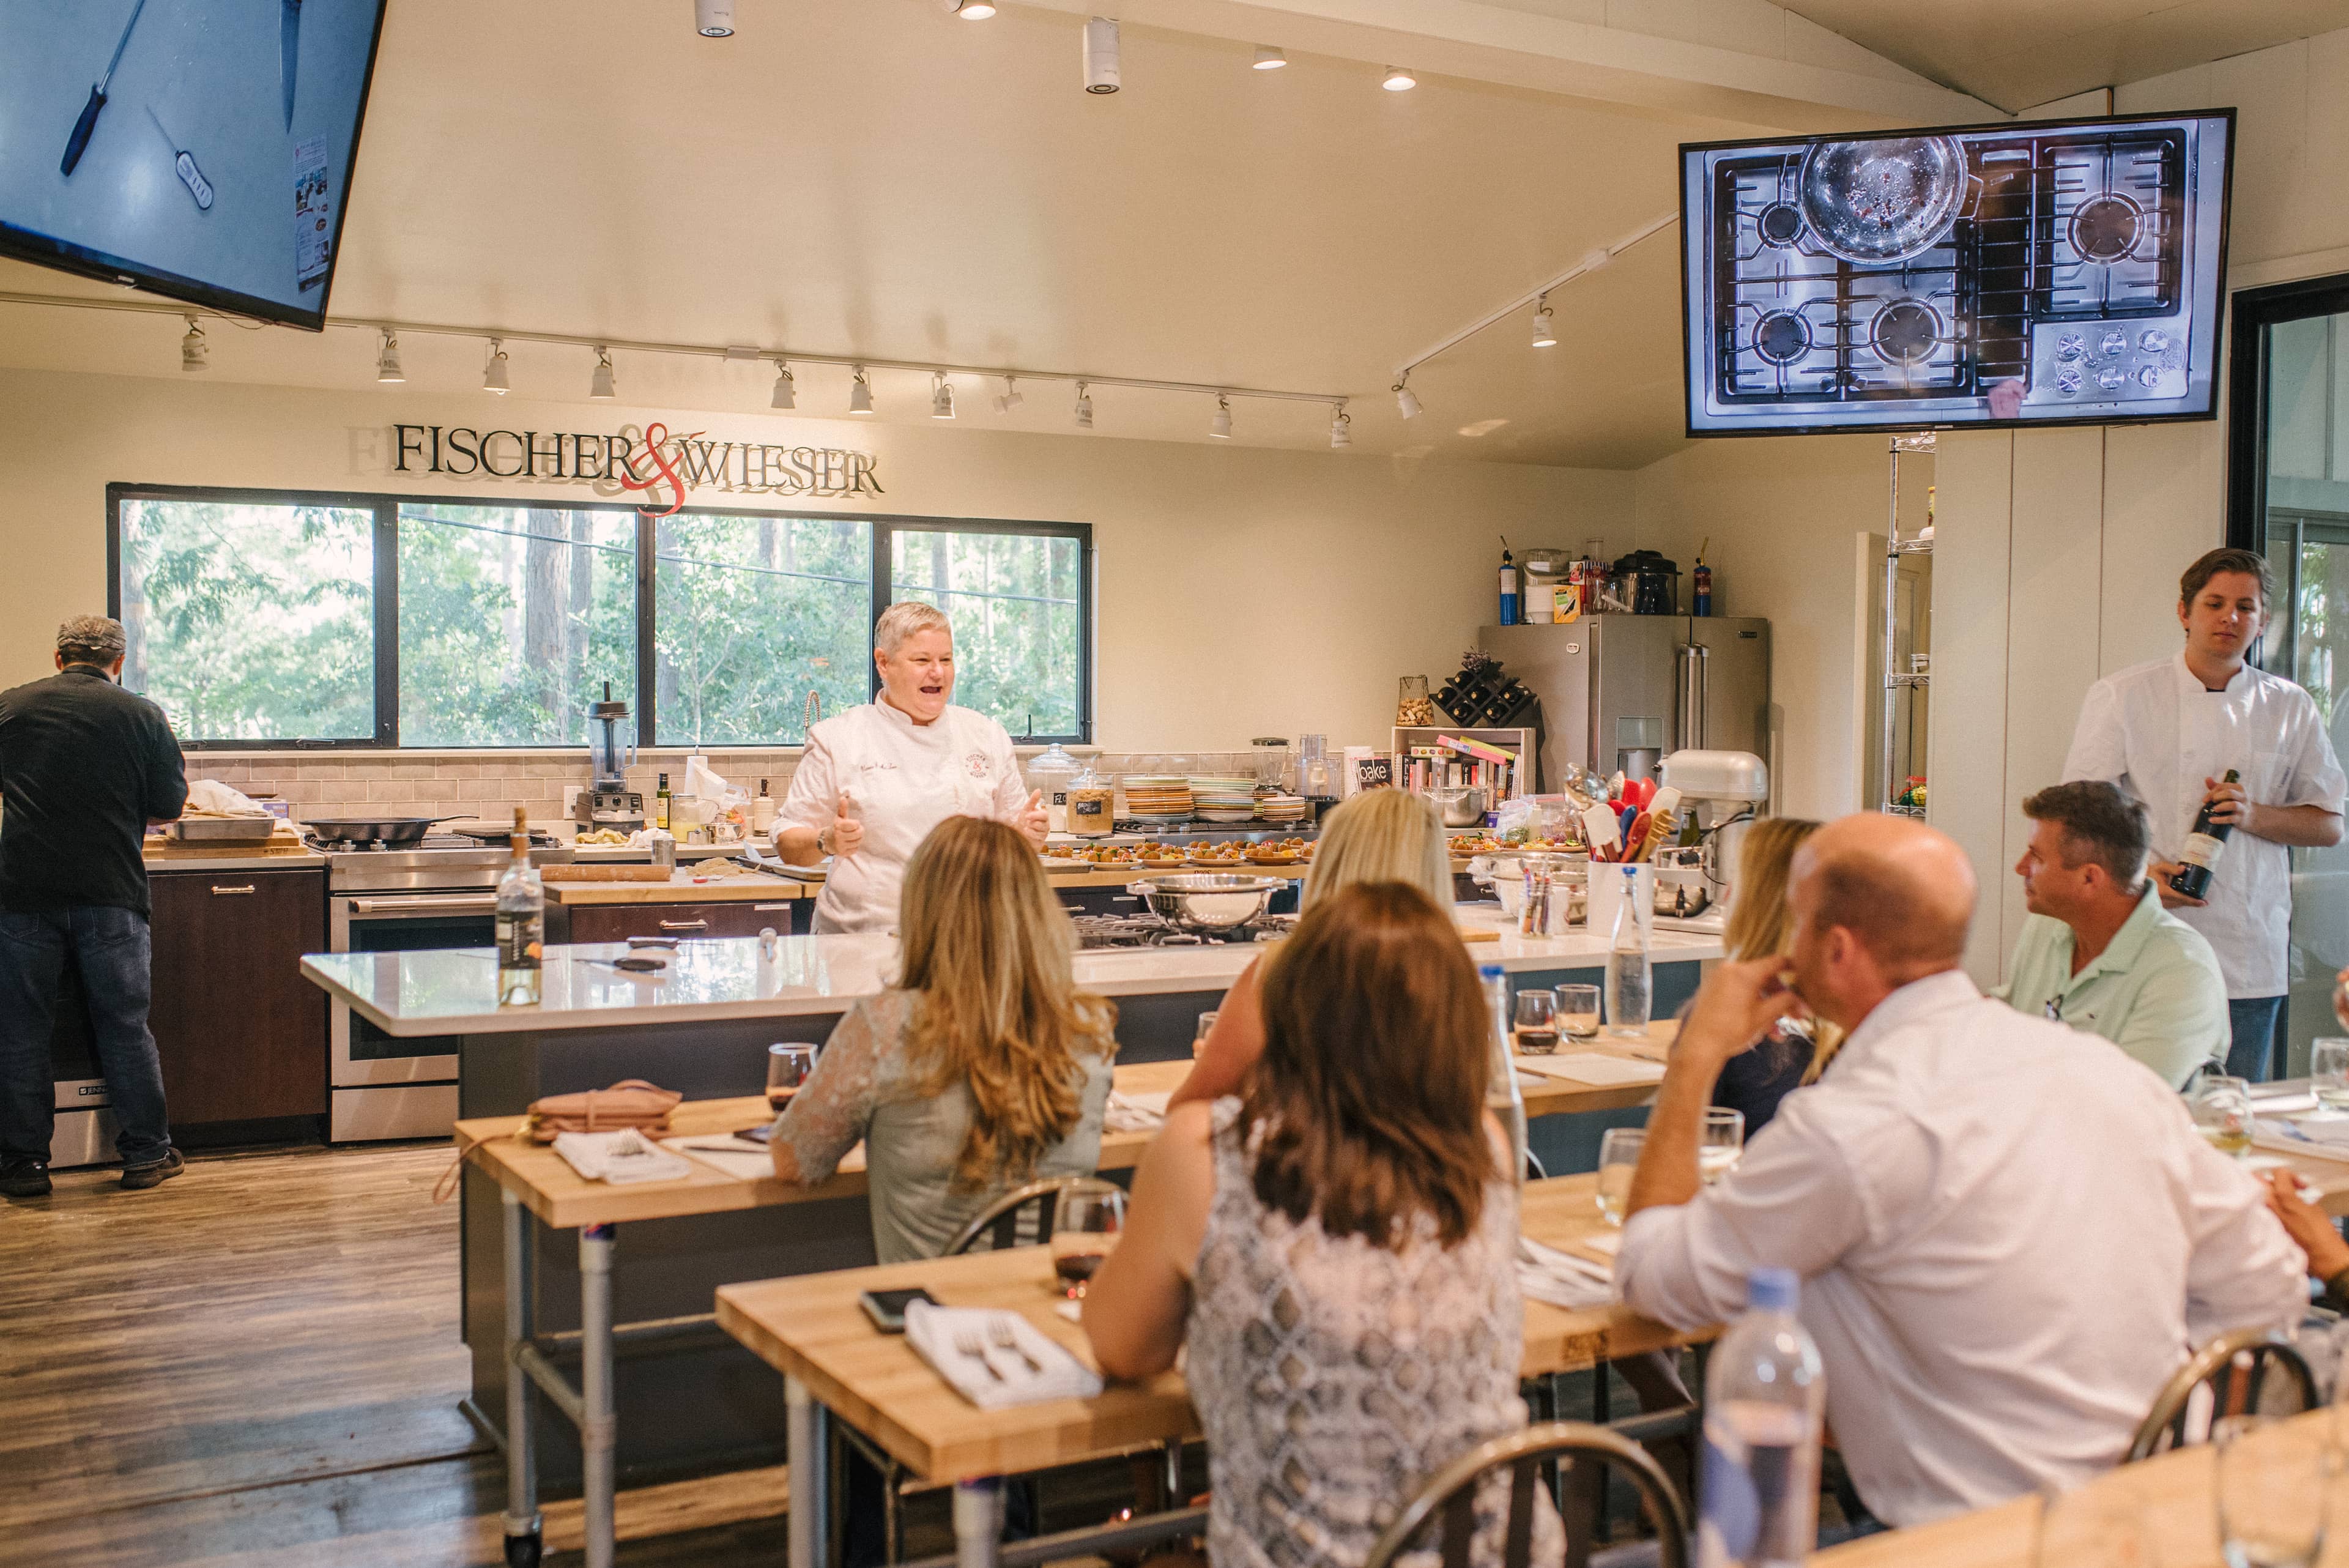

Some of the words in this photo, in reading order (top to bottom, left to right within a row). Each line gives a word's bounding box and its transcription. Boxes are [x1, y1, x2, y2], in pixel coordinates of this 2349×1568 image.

[393, 424, 642, 481] FISCHER
[621, 422, 706, 518] &
[678, 439, 885, 493] WIESER
[1357, 759, 1387, 780] bake
